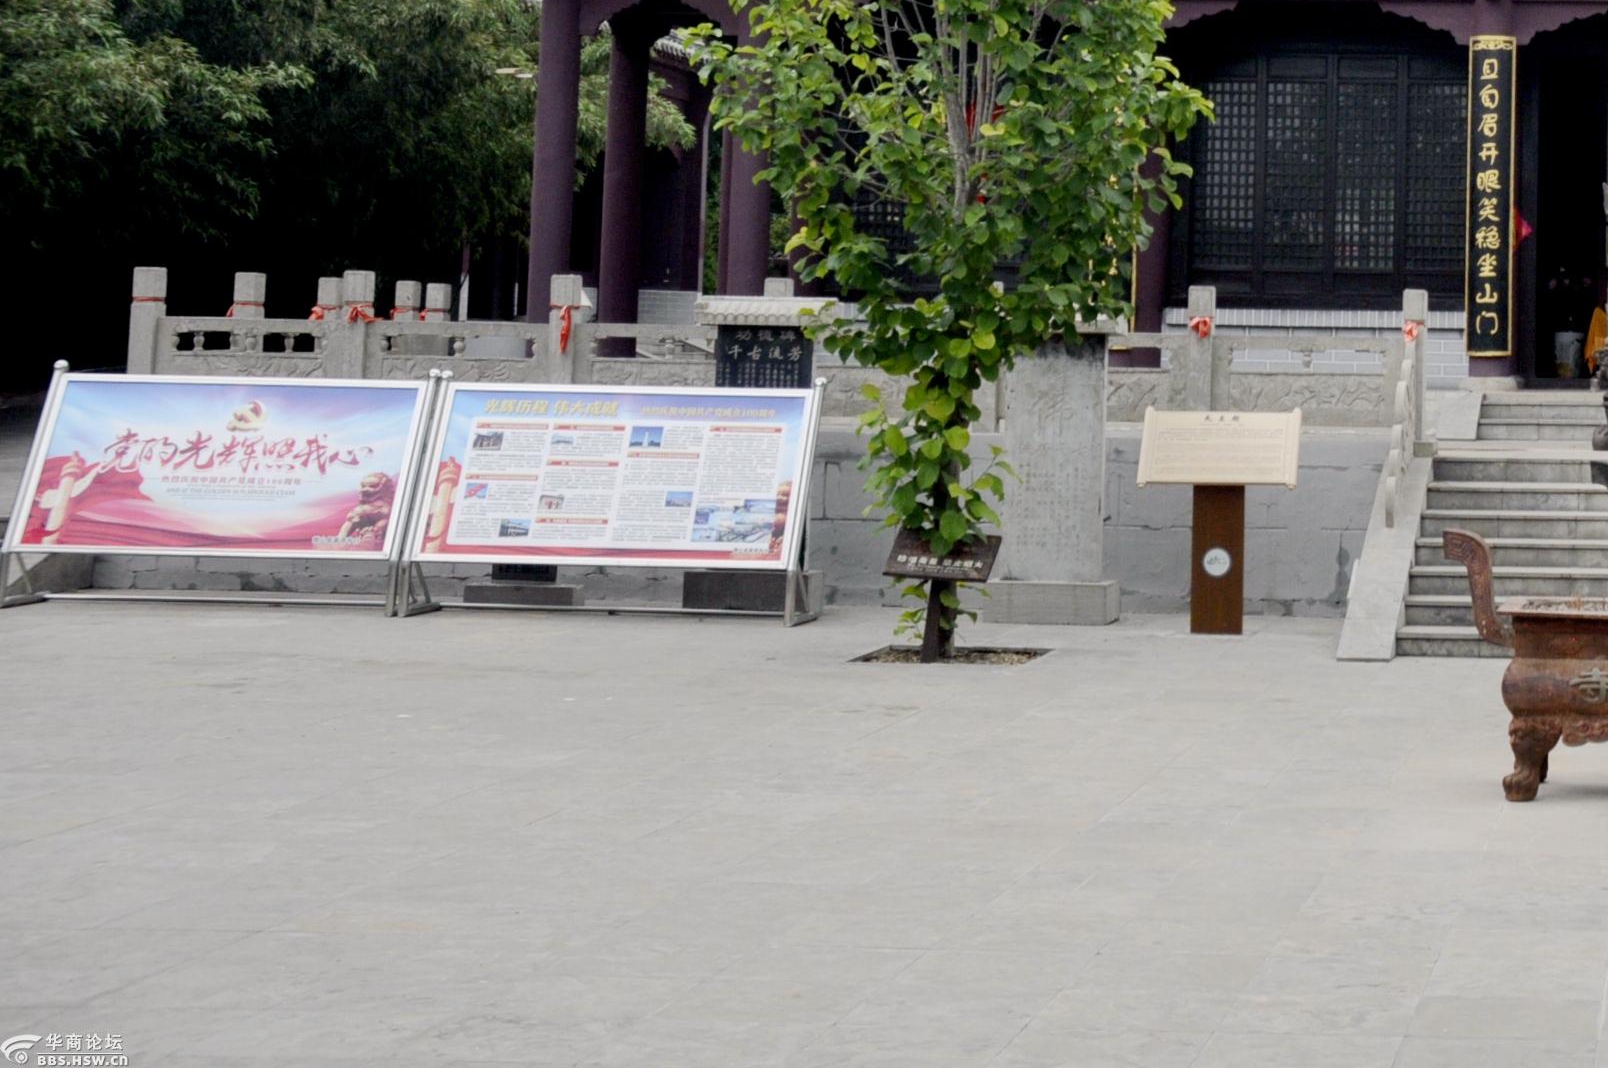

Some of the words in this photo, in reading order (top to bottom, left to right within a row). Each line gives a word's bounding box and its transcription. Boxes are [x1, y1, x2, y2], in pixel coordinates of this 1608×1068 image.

[1475, 58, 1501, 336] 且自眉开眼笑稳坐山门
[727, 344, 804, 362] 千古流芳
[99, 427, 374, 475] 党的光辉照我心
